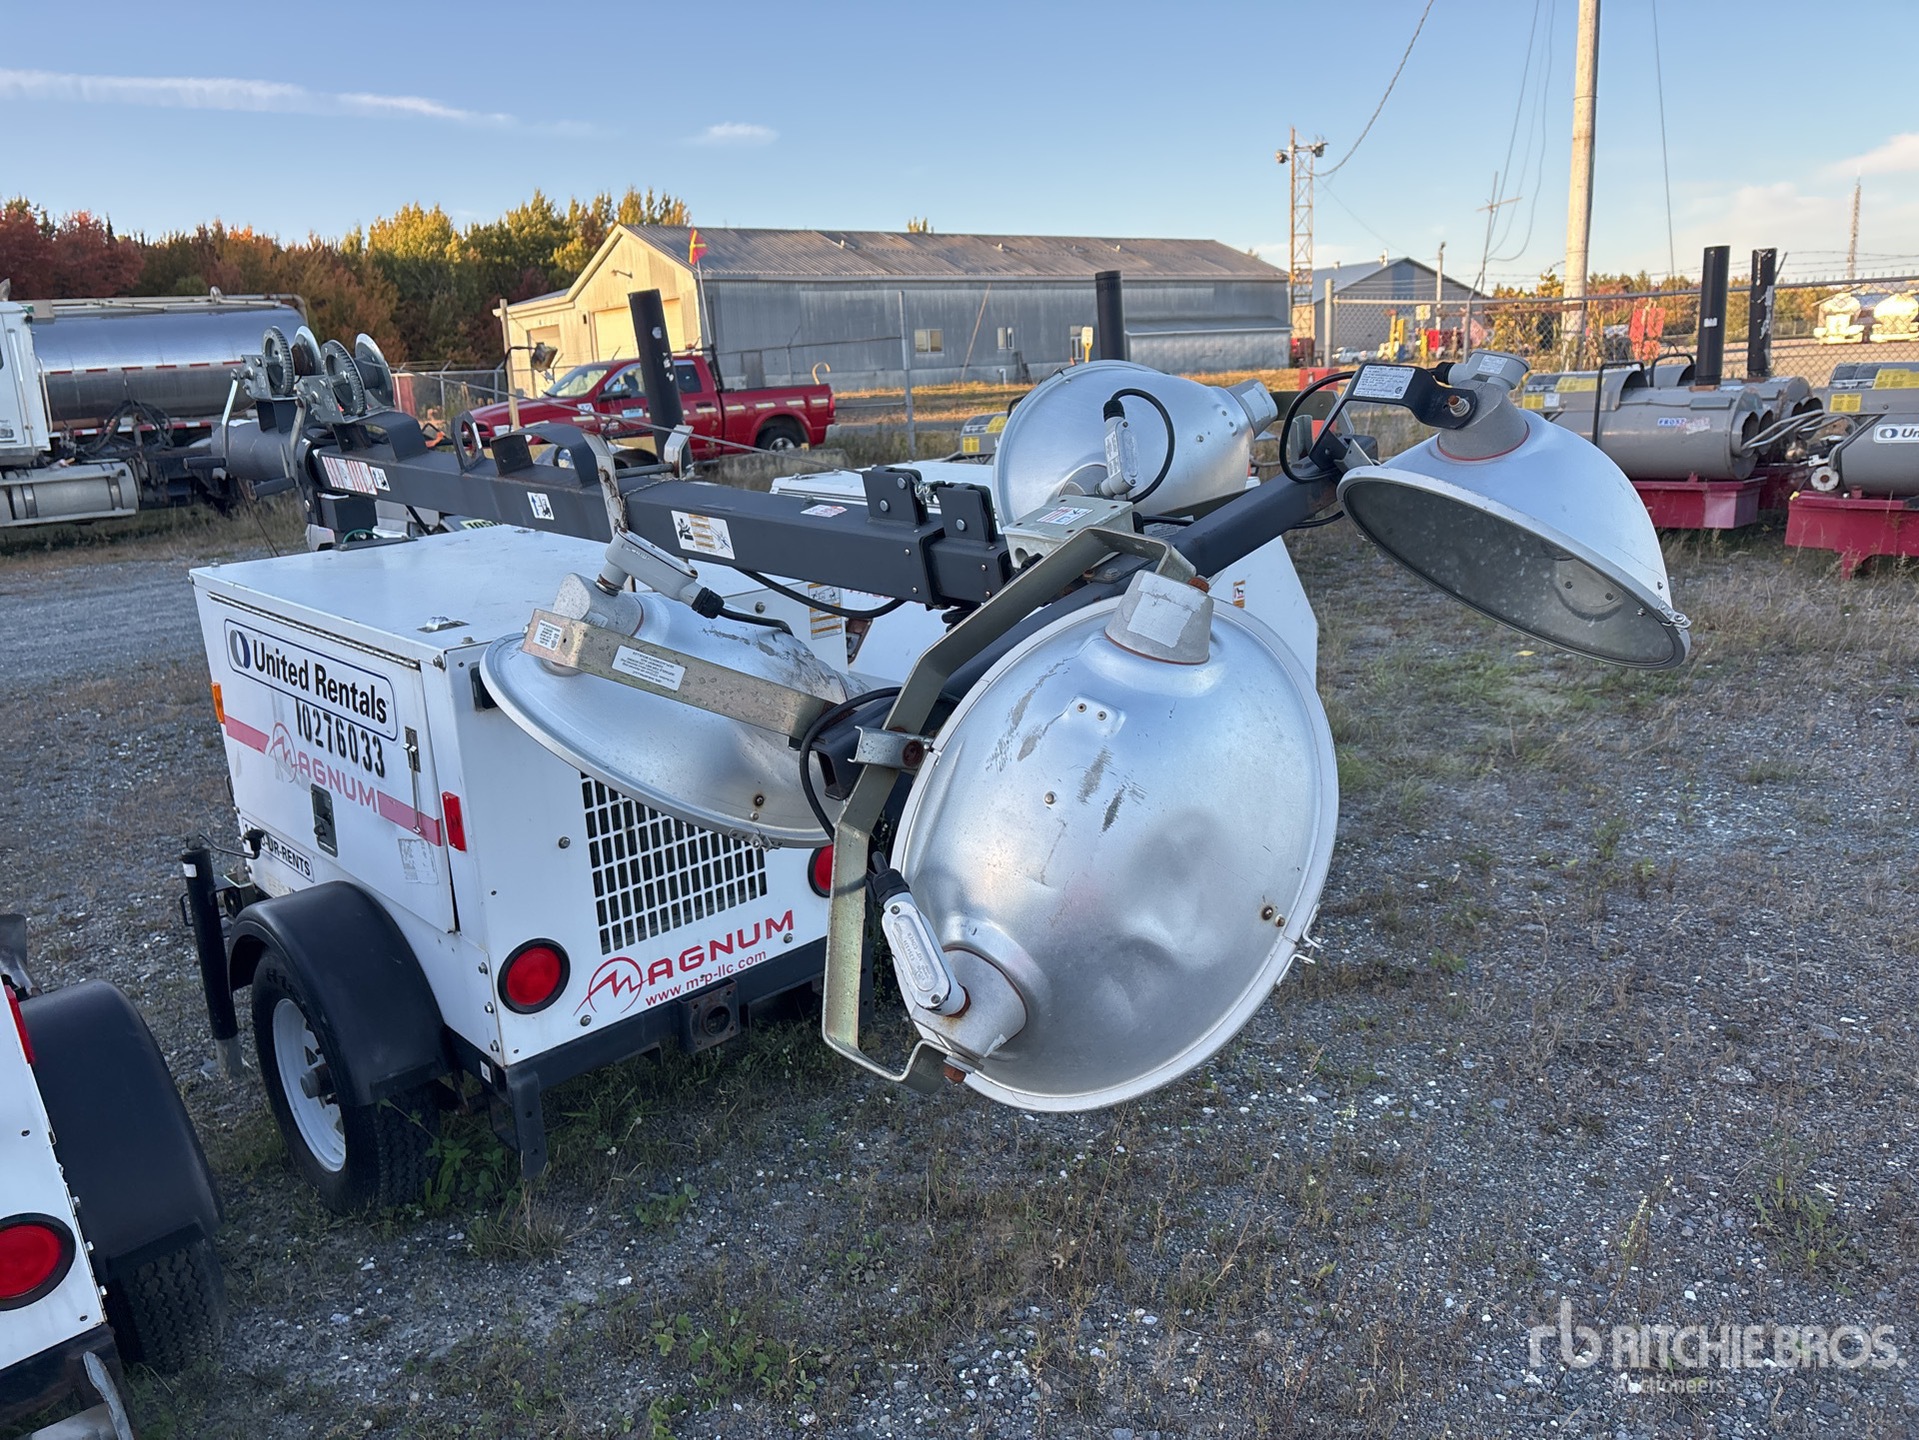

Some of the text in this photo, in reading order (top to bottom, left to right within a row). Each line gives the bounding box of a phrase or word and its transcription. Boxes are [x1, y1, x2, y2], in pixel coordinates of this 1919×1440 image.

[253, 639, 387, 725] United Rentals
[269, 721, 379, 814] MAGNUM
[295, 697, 385, 778] 10276033
[573, 908, 795, 1015] MAGNUM
[645, 950, 768, 1007] www.m-p-llc.com
